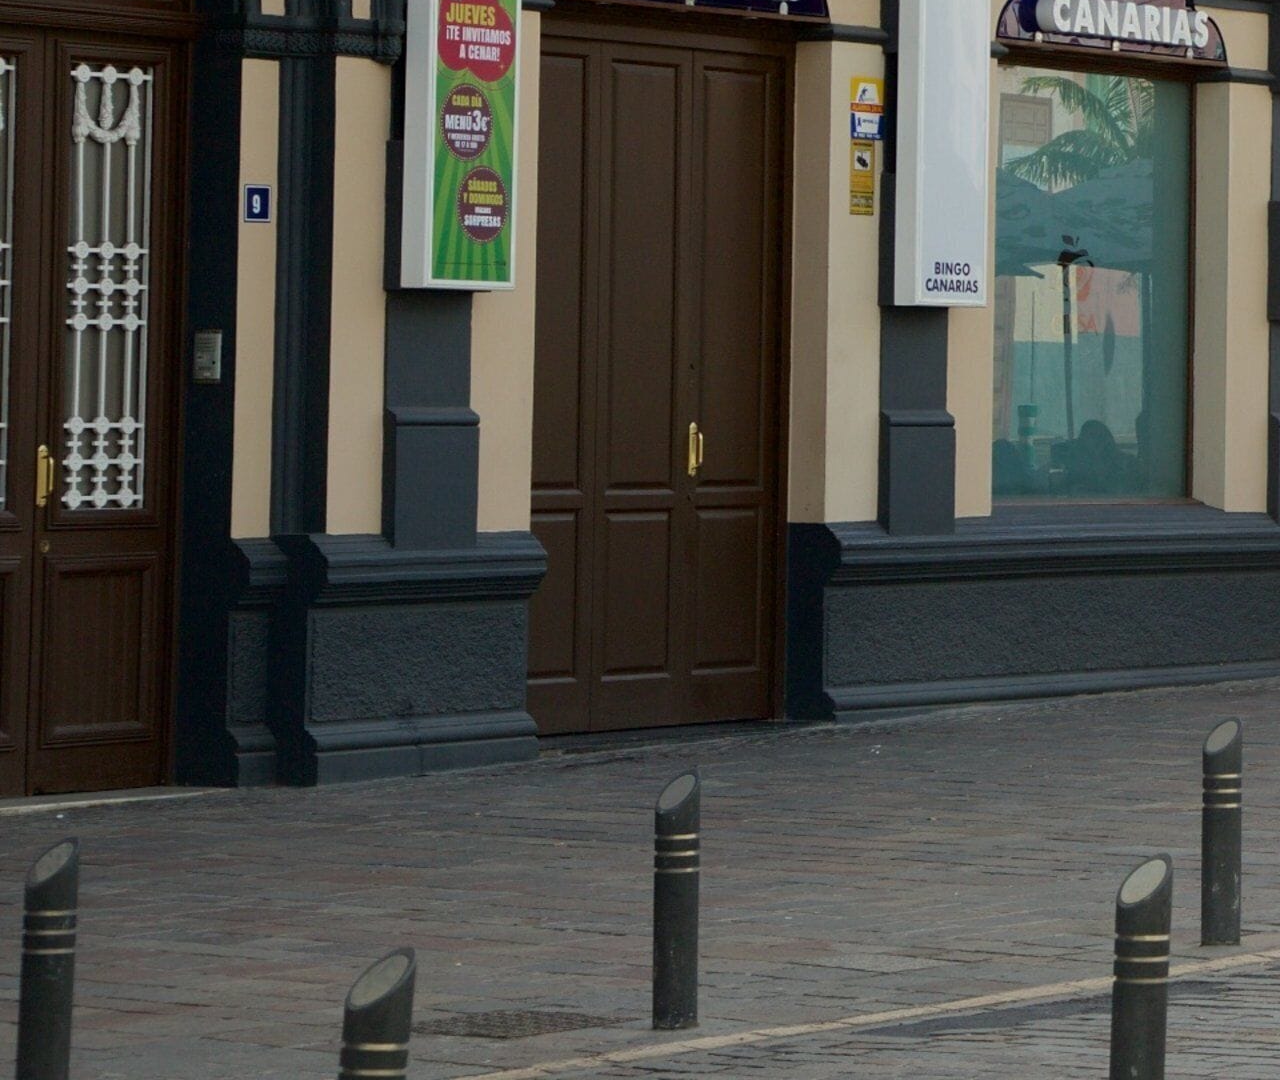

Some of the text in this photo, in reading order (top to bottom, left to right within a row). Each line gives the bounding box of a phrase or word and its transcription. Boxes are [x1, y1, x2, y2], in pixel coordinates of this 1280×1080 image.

[446, 2, 496, 26] JUEVES
[446, 24, 512, 46] ¡TE INVITAMOS
[459, 43, 501, 62] A CENAR!
[445, 111, 472, 131] MENÚ
[252, 194, 261, 214] 9
[934, 261, 971, 276] BINGO
[925, 278, 979, 294] CANARIAS
